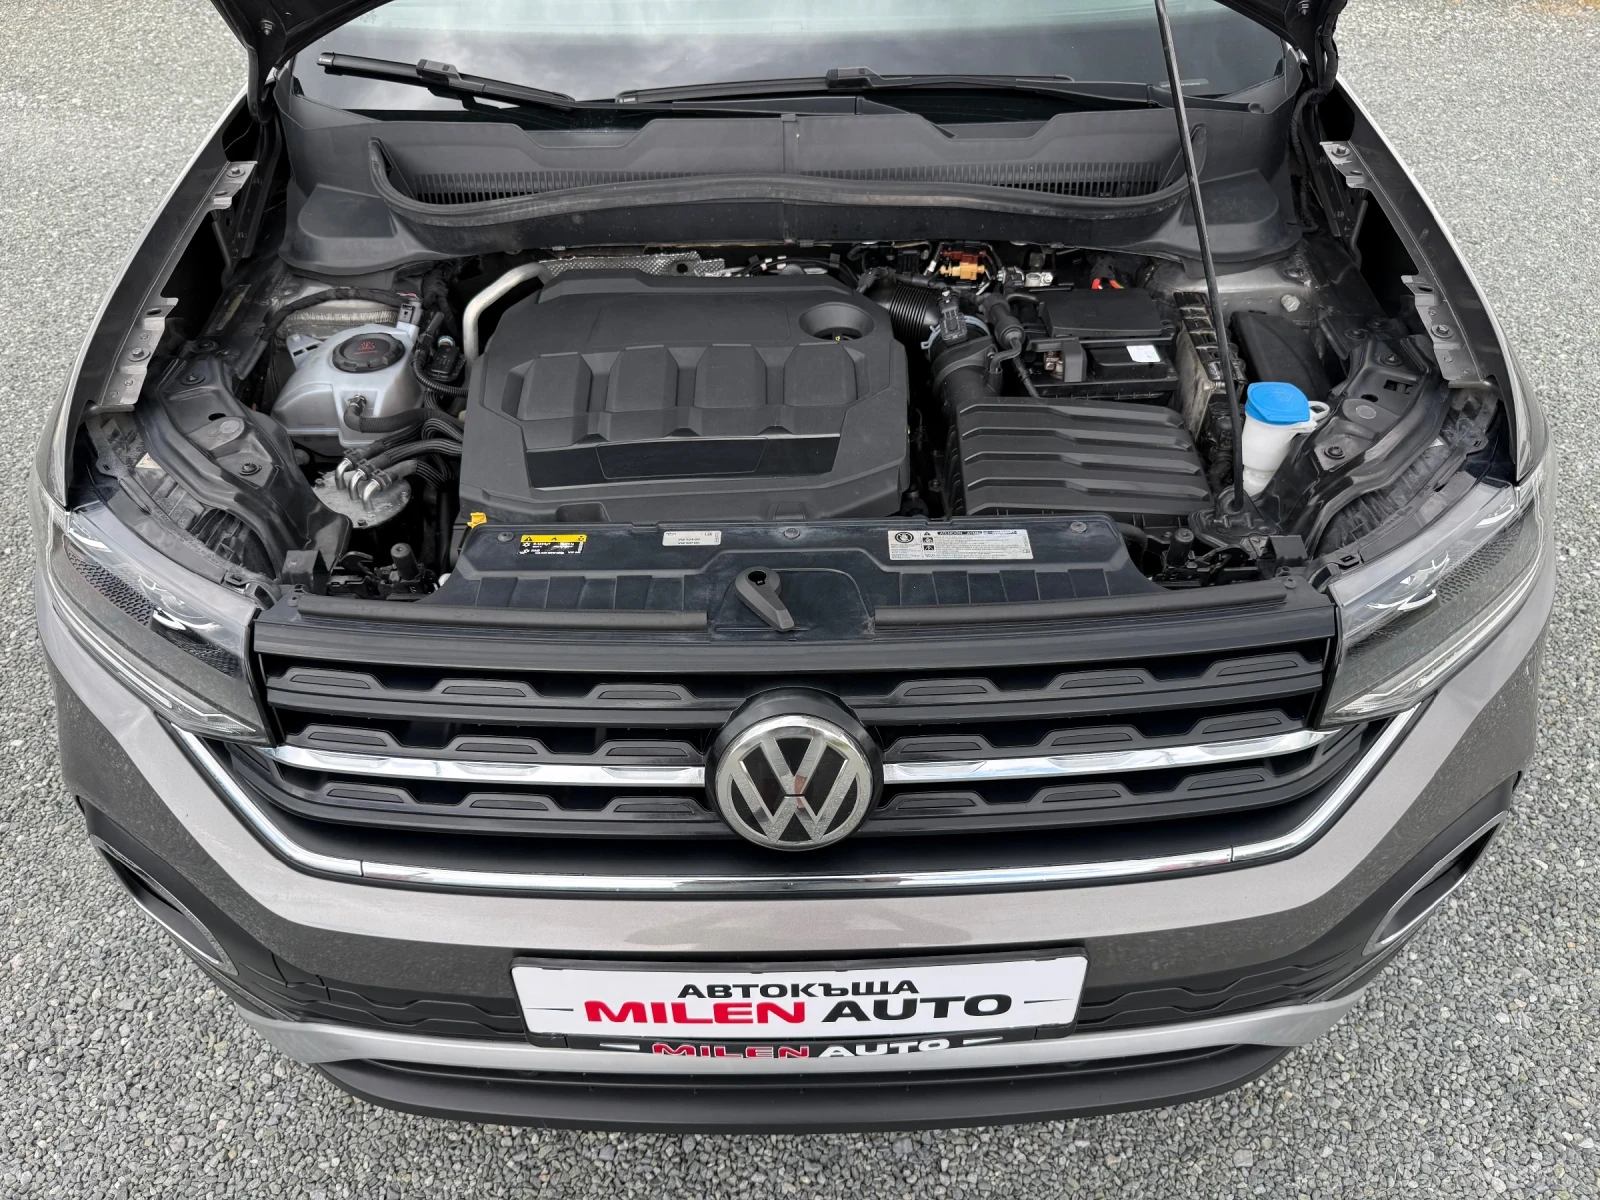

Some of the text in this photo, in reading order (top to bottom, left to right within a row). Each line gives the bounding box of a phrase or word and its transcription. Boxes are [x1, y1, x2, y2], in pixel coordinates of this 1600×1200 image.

[727, 730, 861, 845] VW
[584, 994, 1012, 1024] MILEN AUTO
[652, 1039, 950, 1058] MILEN AUTO
